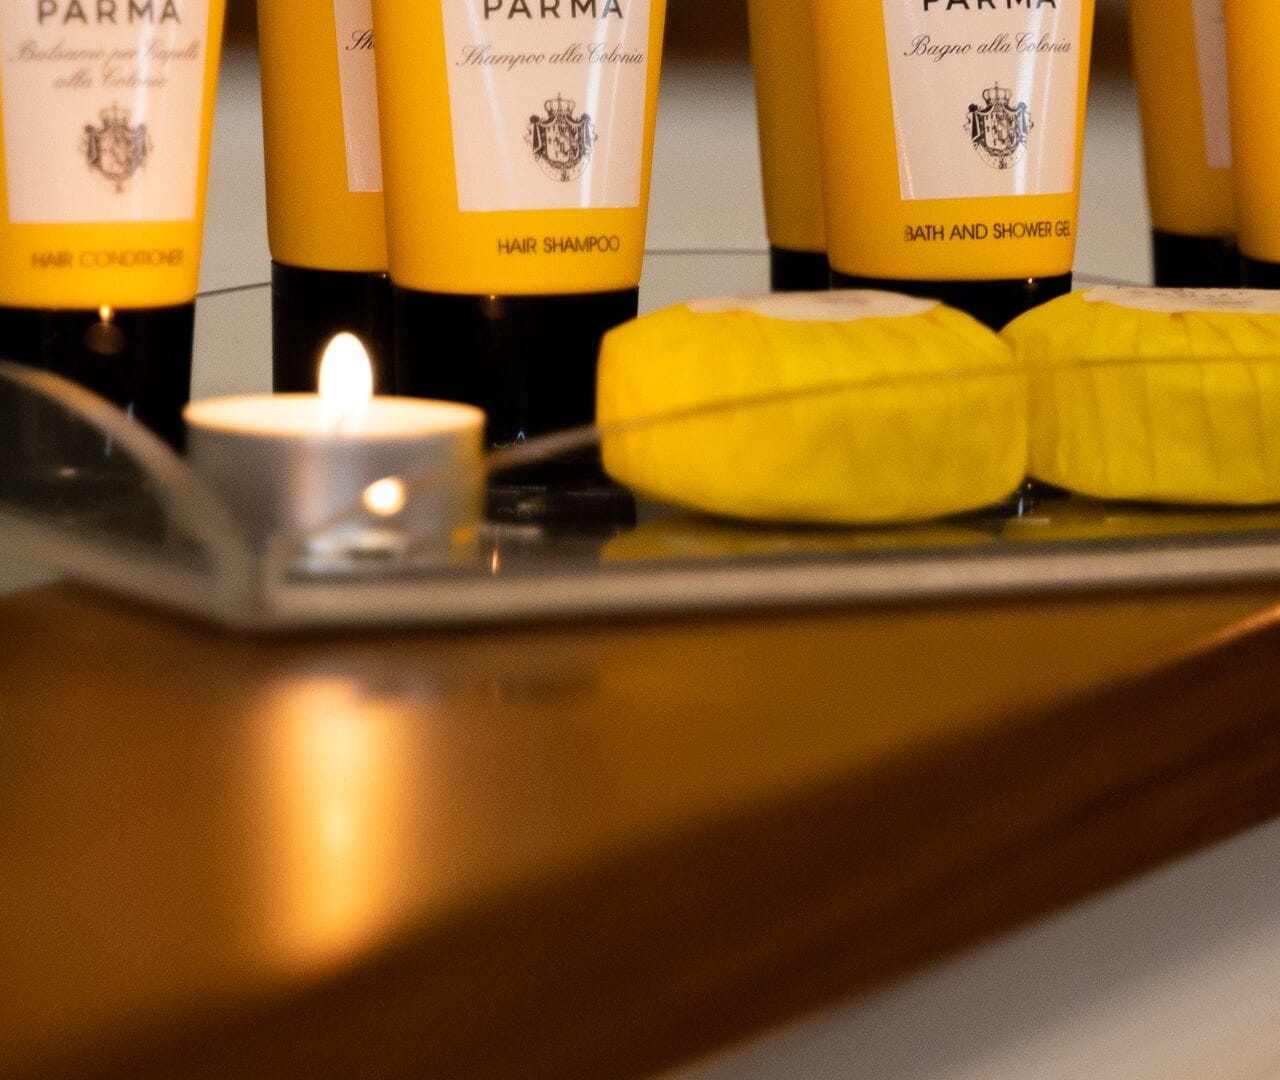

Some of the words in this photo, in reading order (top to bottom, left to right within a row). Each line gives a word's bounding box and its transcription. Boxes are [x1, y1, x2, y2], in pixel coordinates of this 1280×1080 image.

[37, 0, 181, 26] PARMA
[455, 43, 546, 72] Shampoo
[548, 44, 585, 65] alla
[586, 42, 645, 64] Colonia
[903, 34, 972, 63] Bagno
[976, 32, 1013, 54] alla
[1014, 31, 1072, 53] Colonia
[904, 224, 945, 241] BATH
[949, 223, 988, 240] AND
[993, 221, 1053, 239] SHOWER
[1055, 220, 1071, 237] GEL
[497, 237, 537, 255] HAIR
[543, 235, 621, 254] SHAMPOO
[31, 251, 73, 268] HAIR
